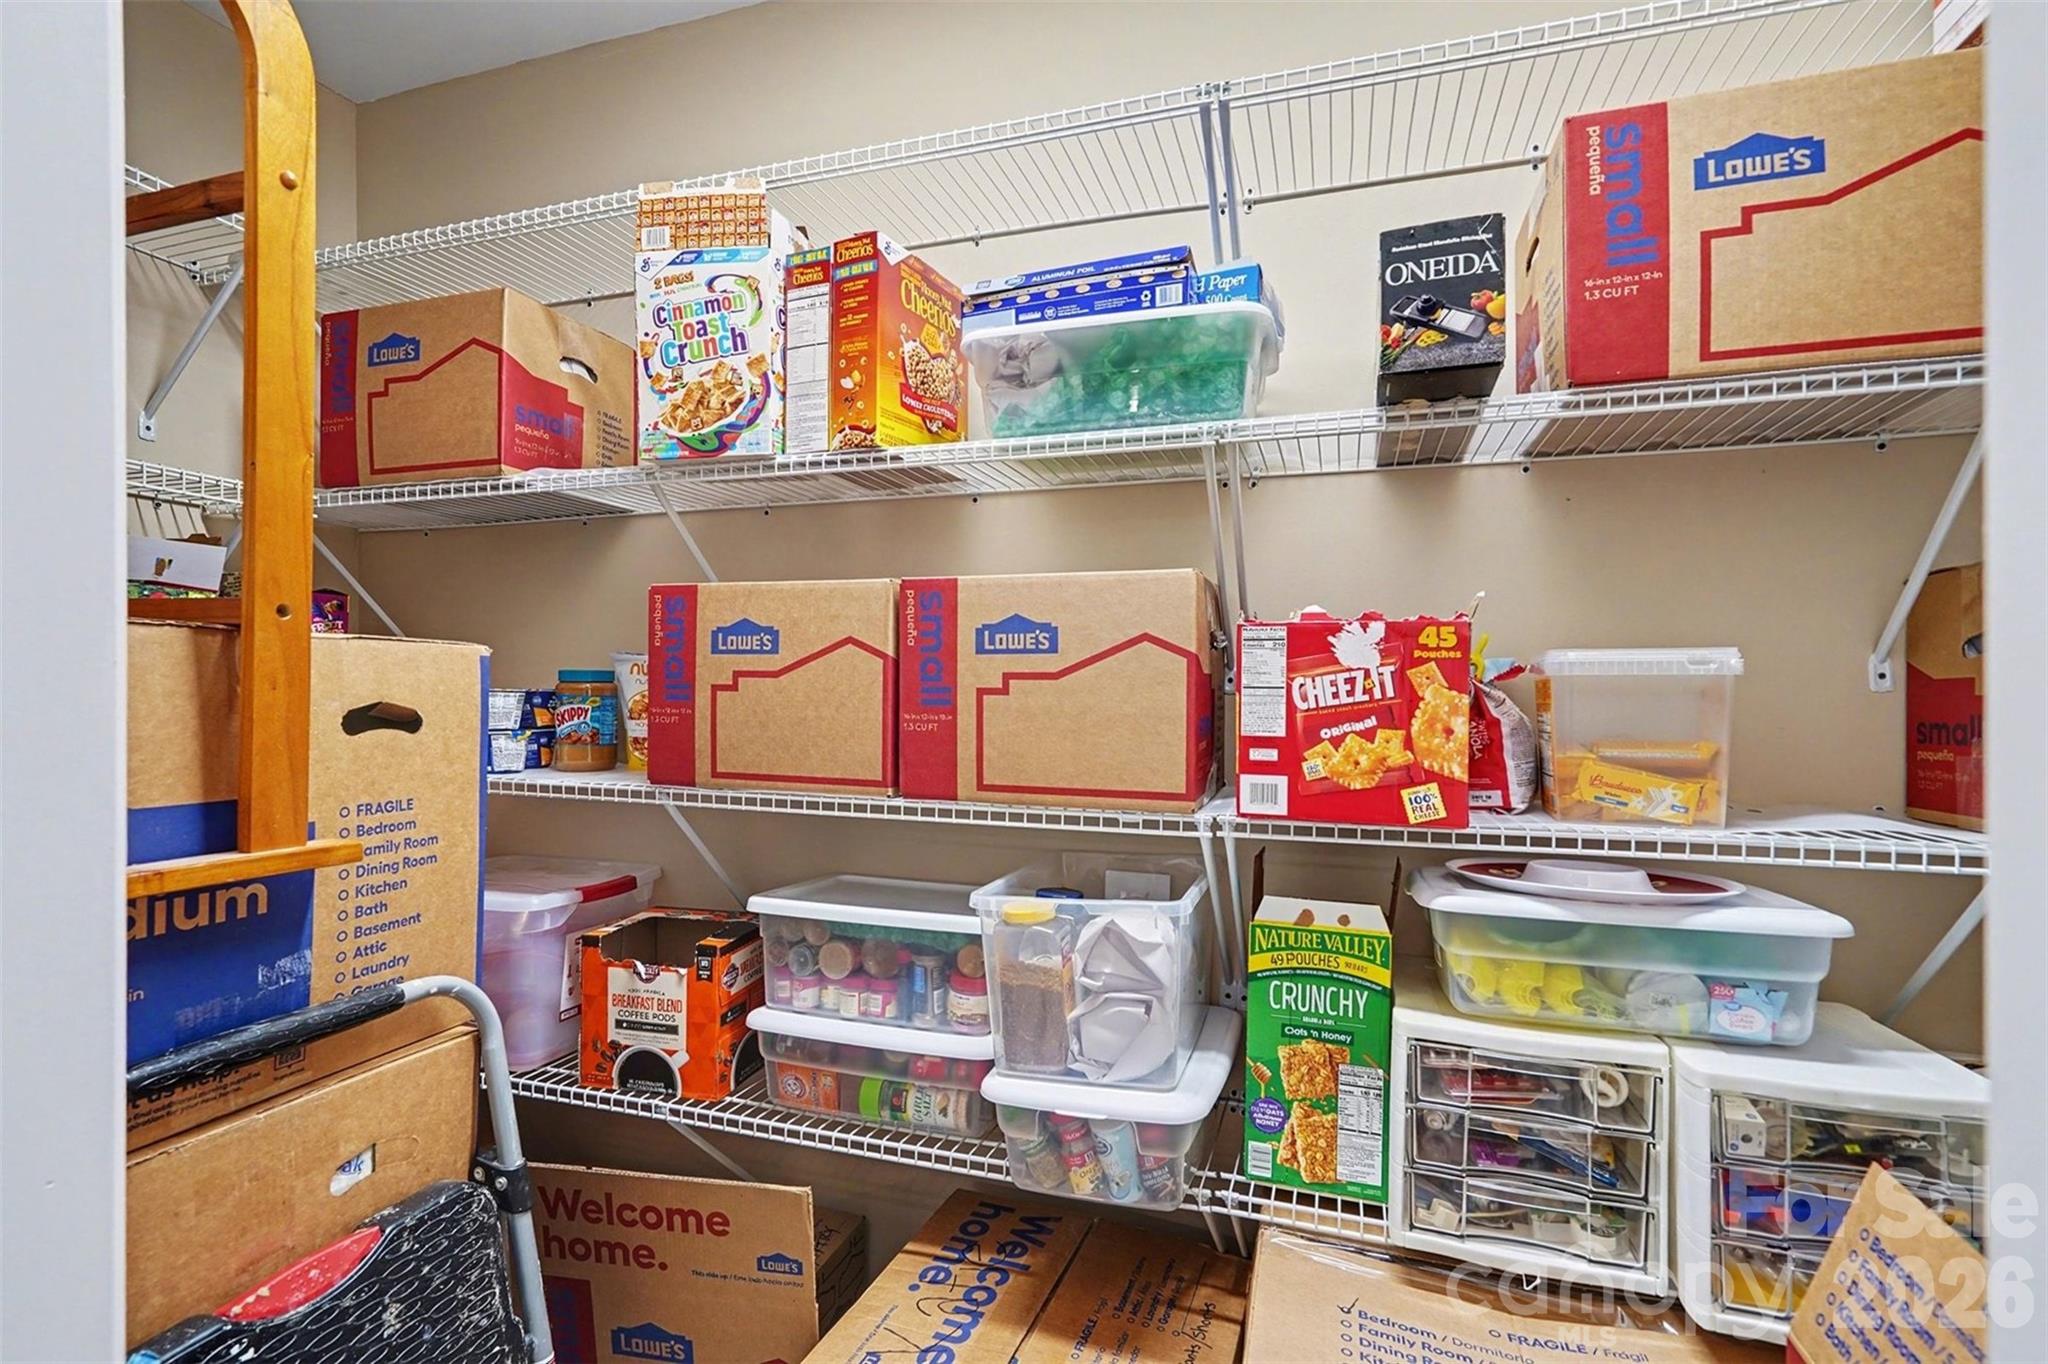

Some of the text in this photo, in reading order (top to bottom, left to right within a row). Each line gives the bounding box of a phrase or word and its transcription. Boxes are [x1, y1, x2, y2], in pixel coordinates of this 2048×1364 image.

[1586, 126, 1605, 196] pequeña
[1707, 147, 1812, 184] LOWE'S
[1604, 122, 1659, 267] small
[836, 245, 873, 263] Cheerios
[1385, 250, 1500, 286] ONEIDA
[1032, 270, 1075, 283] ALUMINUM
[1076, 266, 1097, 276] FOIL
[1208, 273, 1248, 292] Paper
[1584, 285, 1640, 300] 1.3 CU FT
[655, 293, 745, 325] Cinnamon
[901, 279, 956, 337] Cheerios
[671, 313, 730, 342] Toast
[373, 342, 416, 362] LOWE'S
[661, 326, 748, 366] Crunch
[906, 589, 918, 647] pequeña
[663, 596, 691, 701] small
[718, 632, 772, 650] LOWE'S
[917, 590, 953, 708] small
[983, 629, 1051, 650] LOWE'S
[1418, 626, 1458, 648] 45
[1414, 650, 1463, 659] Pouches
[555, 706, 590, 728] SKIPPY
[356, 798, 414, 818] FRAGILE
[1412, 803, 1439, 815] REAL
[356, 819, 417, 838] Bedroom
[363, 834, 439, 857] amily Room
[355, 853, 438, 879] Dining Room
[354, 878, 408, 899] Kitchen
[354, 900, 388, 919] Bath
[353, 912, 422, 940] Basement
[352, 941, 388, 960] Attic
[1254, 927, 1386, 965] NATURE VALLEY
[1270, 954, 1284, 966] 49
[1286, 952, 1341, 969] POUCHES
[351, 953, 410, 980] Laundry
[612, 993, 683, 1013] BREAKFAST BLEND
[1269, 980, 1369, 1020] CRUNCHY
[618, 1009, 676, 1023] COFFEE PODS
[1284, 1026, 1308, 1036] Oats
[1321, 1031, 1352, 1044] Honey
[537, 1185, 731, 1238] Welcome
[540, 1225, 669, 1272] home.
[908, 1201, 1016, 1293] home.
[761, 1259, 799, 1273] LOWE'S
[1869, 1236, 1925, 1300] Bedroom
[916, 1214, 1064, 1364] Welcome
[1859, 1258, 1899, 1308] Family
[1898, 1302, 1936, 1350] Room
[1074, 1317, 1099, 1353] FRAGILE
[1836, 1301, 1880, 1360] Kitchen
[1847, 1279, 1922, 1364] Dining Room
[619, 1332, 686, 1361] LOWE'S
[1358, 1309, 1437, 1341] Bedroom
[1451, 1337, 1535, 1364] Dormitorio
[1358, 1322, 1474, 1364] Family Room
[1358, 1336, 1417, 1363] Dining
[1507, 1332, 1588, 1355] FRAGILE
[1602, 1347, 1650, 1364] Frágil
[1825, 1323, 1852, 1363] Bath
